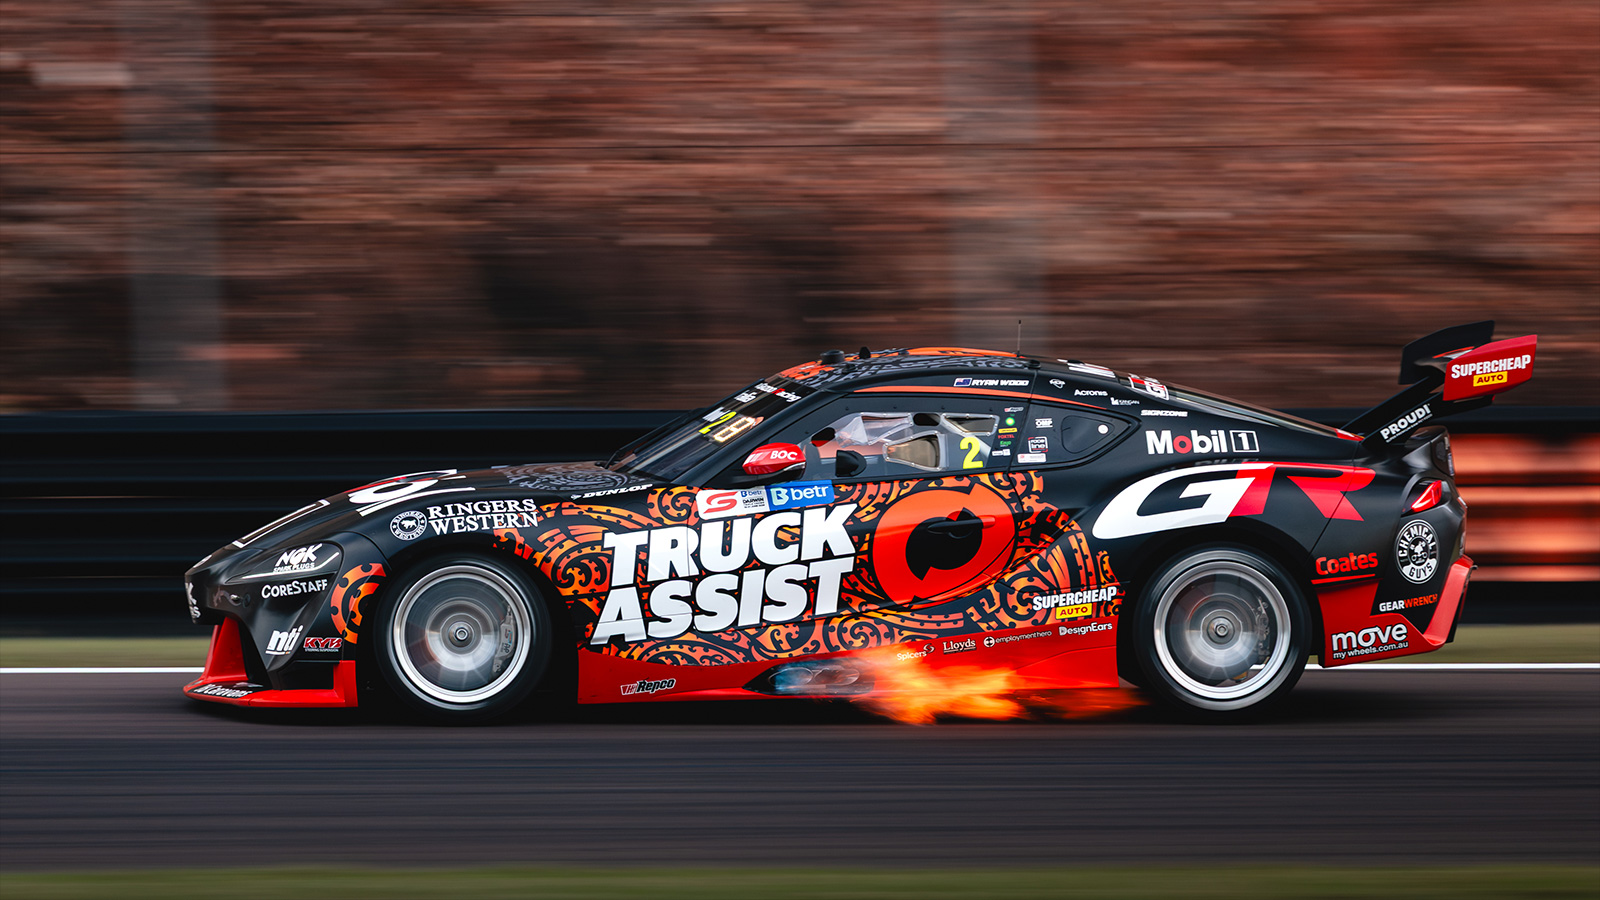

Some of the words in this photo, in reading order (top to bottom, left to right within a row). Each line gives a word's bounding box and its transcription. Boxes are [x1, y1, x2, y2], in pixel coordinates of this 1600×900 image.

[1451, 354, 1531, 378] SUPERCHEAP
[1477, 374, 1504, 384] AUTO
[1145, 430, 1228, 455] Mobil
[770, 450, 798, 460] BOC
[960, 437, 984, 469] 2
[582, 484, 653, 499] DUNLOP
[791, 485, 829, 500] betr
[1092, 461, 1376, 540] GR
[427, 499, 537, 519] RINGERS
[429, 512, 539, 535] WESTERN
[603, 503, 857, 587] TRUCK
[1398, 525, 1436, 557] CHEMICAL
[275, 543, 323, 566] NGK
[1315, 552, 1378, 576] Coates
[1408, 562, 1433, 579] GUYS
[590, 556, 855, 645] ASSIST
[1032, 586, 1117, 611] SUPERCHEAP
[1379, 593, 1438, 612] GEARWRENCH
[1060, 606, 1088, 615] AUTO
[1058, 622, 1113, 636] DesignEars
[1331, 623, 1407, 651] move
[303, 637, 343, 649] KYB
[943, 639, 976, 651] Lloyds
[896, 651, 927, 661] Spicers
[1333, 650, 1346, 660] my
[635, 678, 676, 694] Repco
